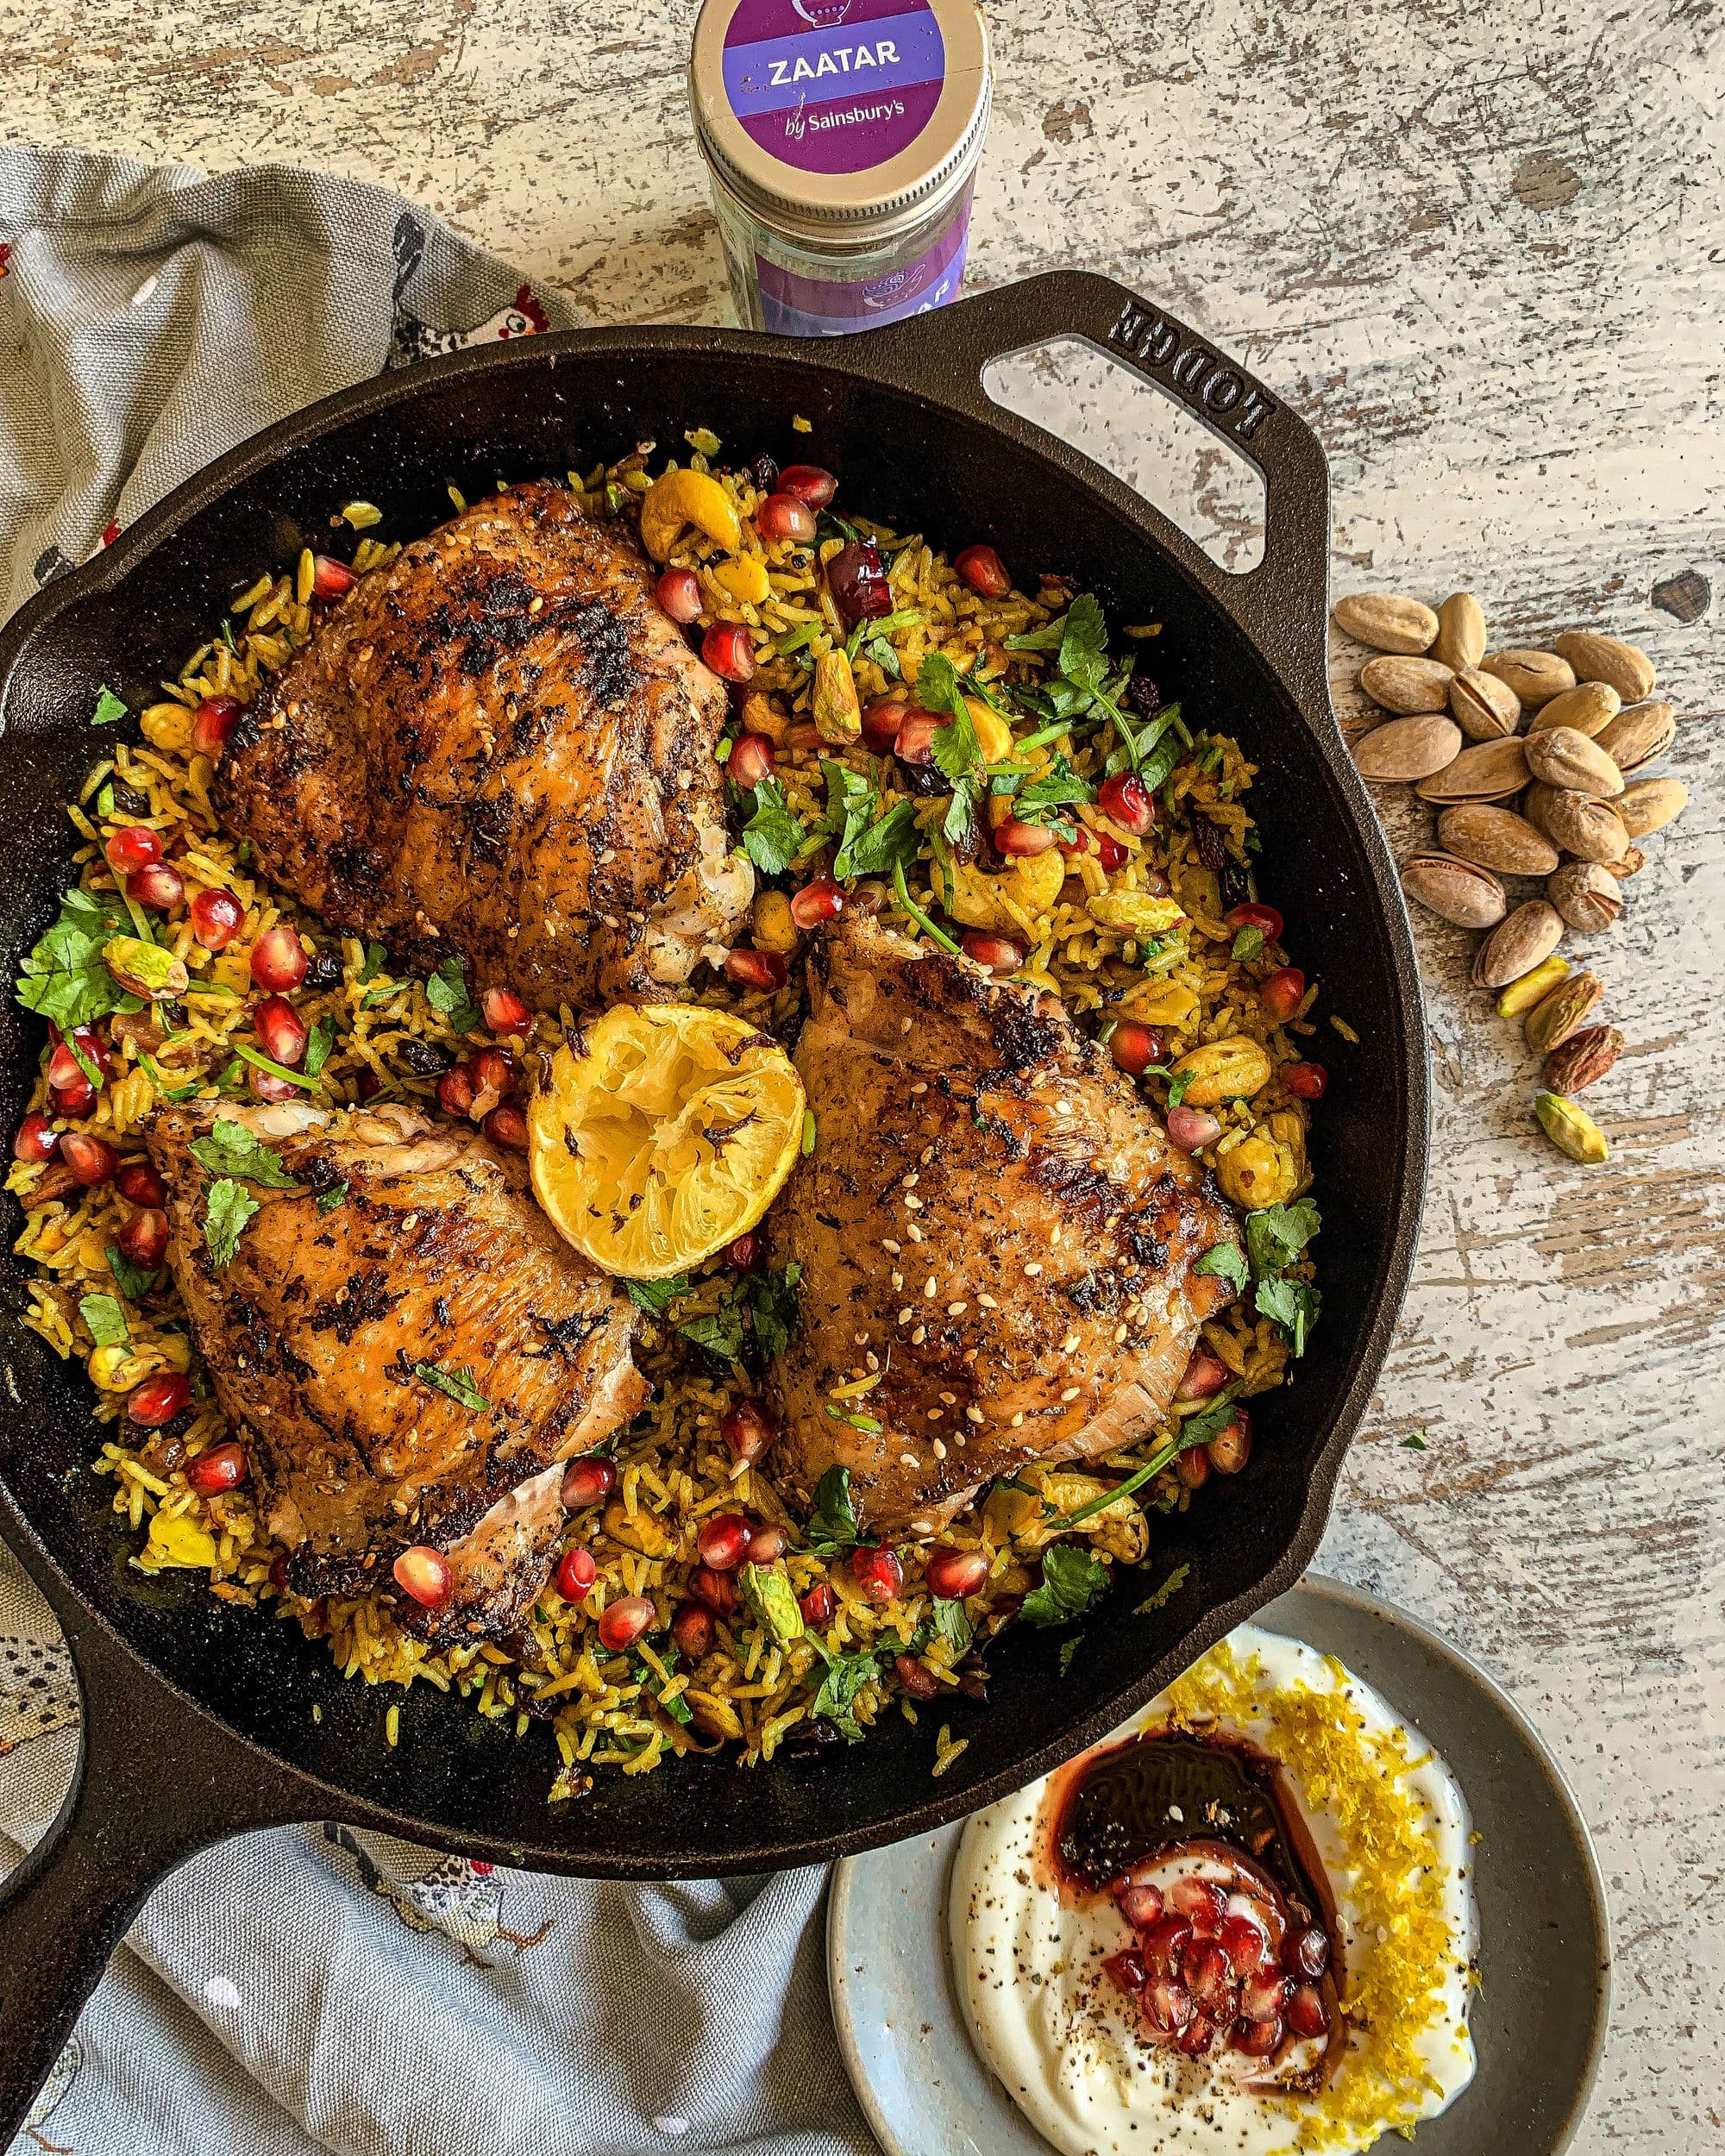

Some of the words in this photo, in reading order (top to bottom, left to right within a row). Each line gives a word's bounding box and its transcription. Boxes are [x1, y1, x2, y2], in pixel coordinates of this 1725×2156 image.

[768, 41, 900, 86] ZAATAR
[785, 107, 806, 140] by
[808, 100, 905, 131] Sainsbury's
[1108, 300, 1277, 441] LODGE
